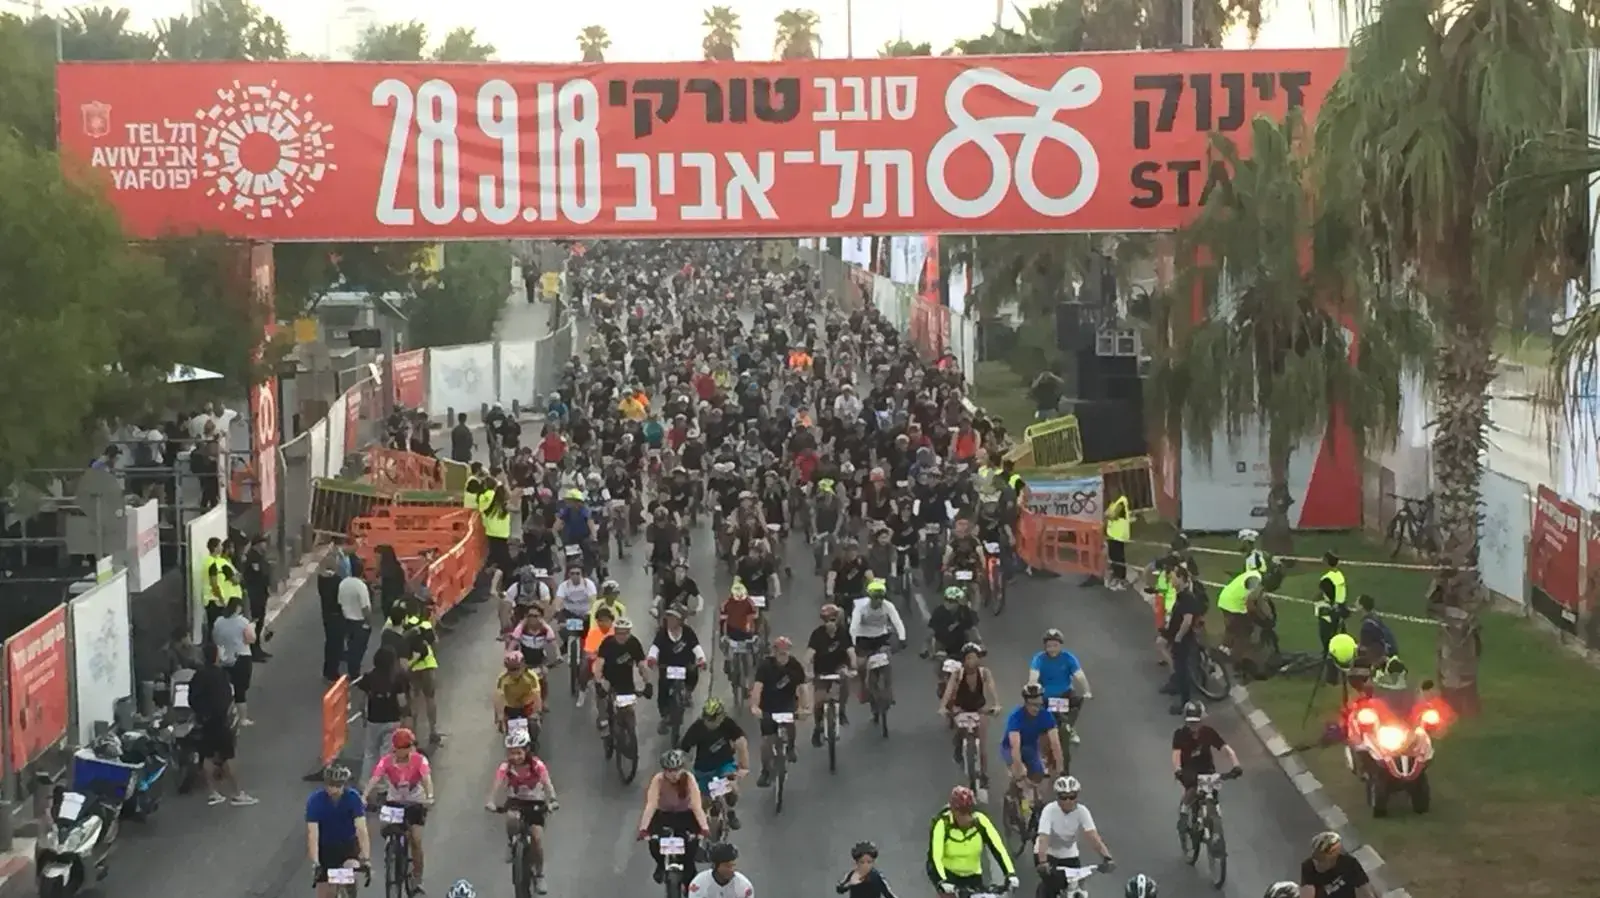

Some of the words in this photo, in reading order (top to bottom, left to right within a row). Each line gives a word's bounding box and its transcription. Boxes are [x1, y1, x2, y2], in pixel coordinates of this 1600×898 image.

[608, 77, 801, 140] טורקי
[812, 75, 918, 122] סובב
[1133, 71, 1312, 150] זינוק
[124, 122, 164, 144] TEL
[371, 78, 602, 225] 28.9.18
[1130, 159, 1244, 209] STA
